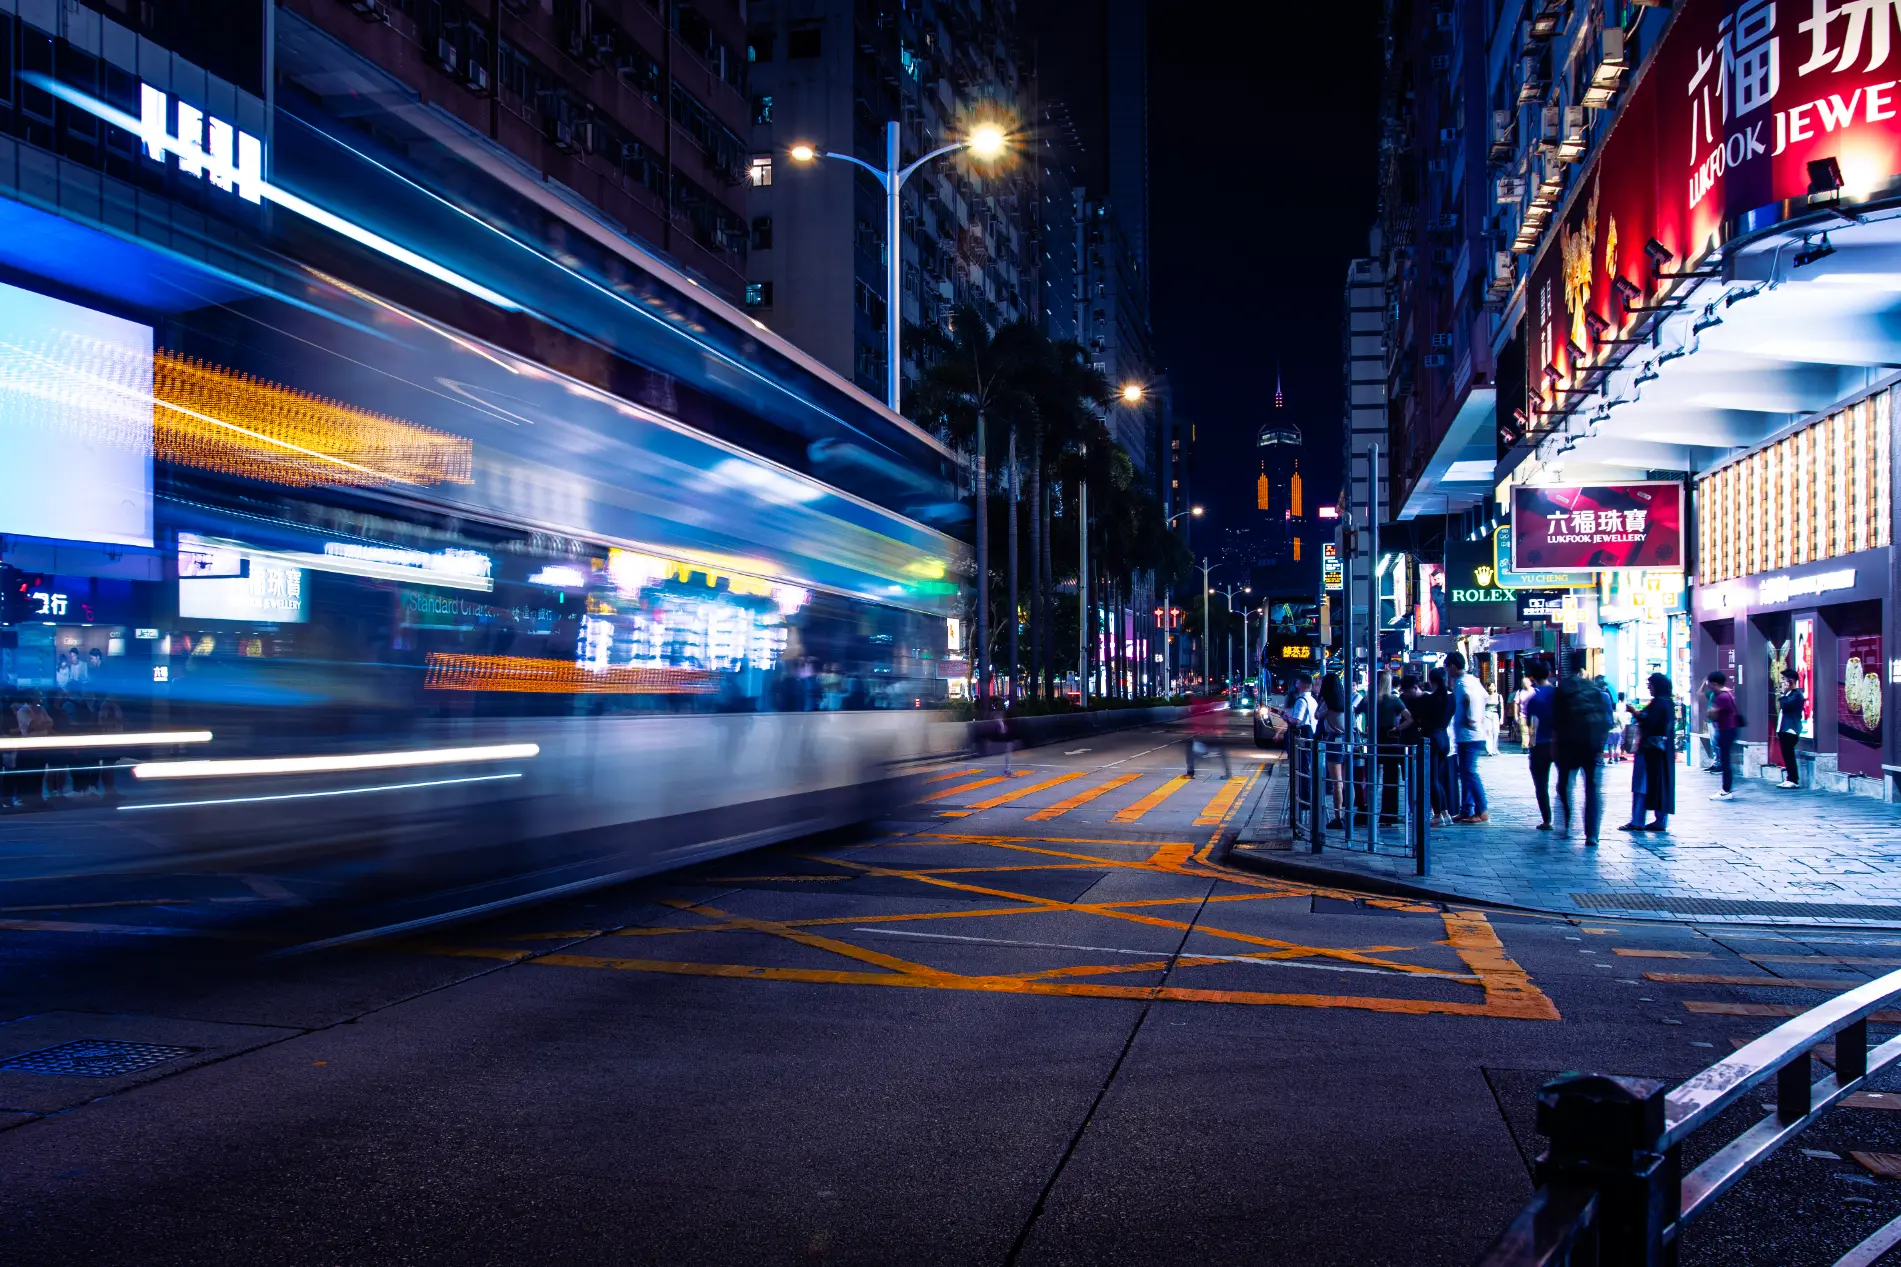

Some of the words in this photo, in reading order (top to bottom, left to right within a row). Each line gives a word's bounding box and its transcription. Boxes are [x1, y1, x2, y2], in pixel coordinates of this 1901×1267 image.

[1689, 121, 1766, 210] LUKFOOK
[1771, 80, 1901, 157] JEWE
[1547, 508, 1648, 534] 六福珠寶
[1547, 534, 1591, 543] LUKFOOK
[1593, 533, 1647, 544] JEWELLERY
[1535, 574, 1569, 583] CHENG
[1451, 589, 1517, 602] ROLEX
[409, 594, 458, 615] Standard
